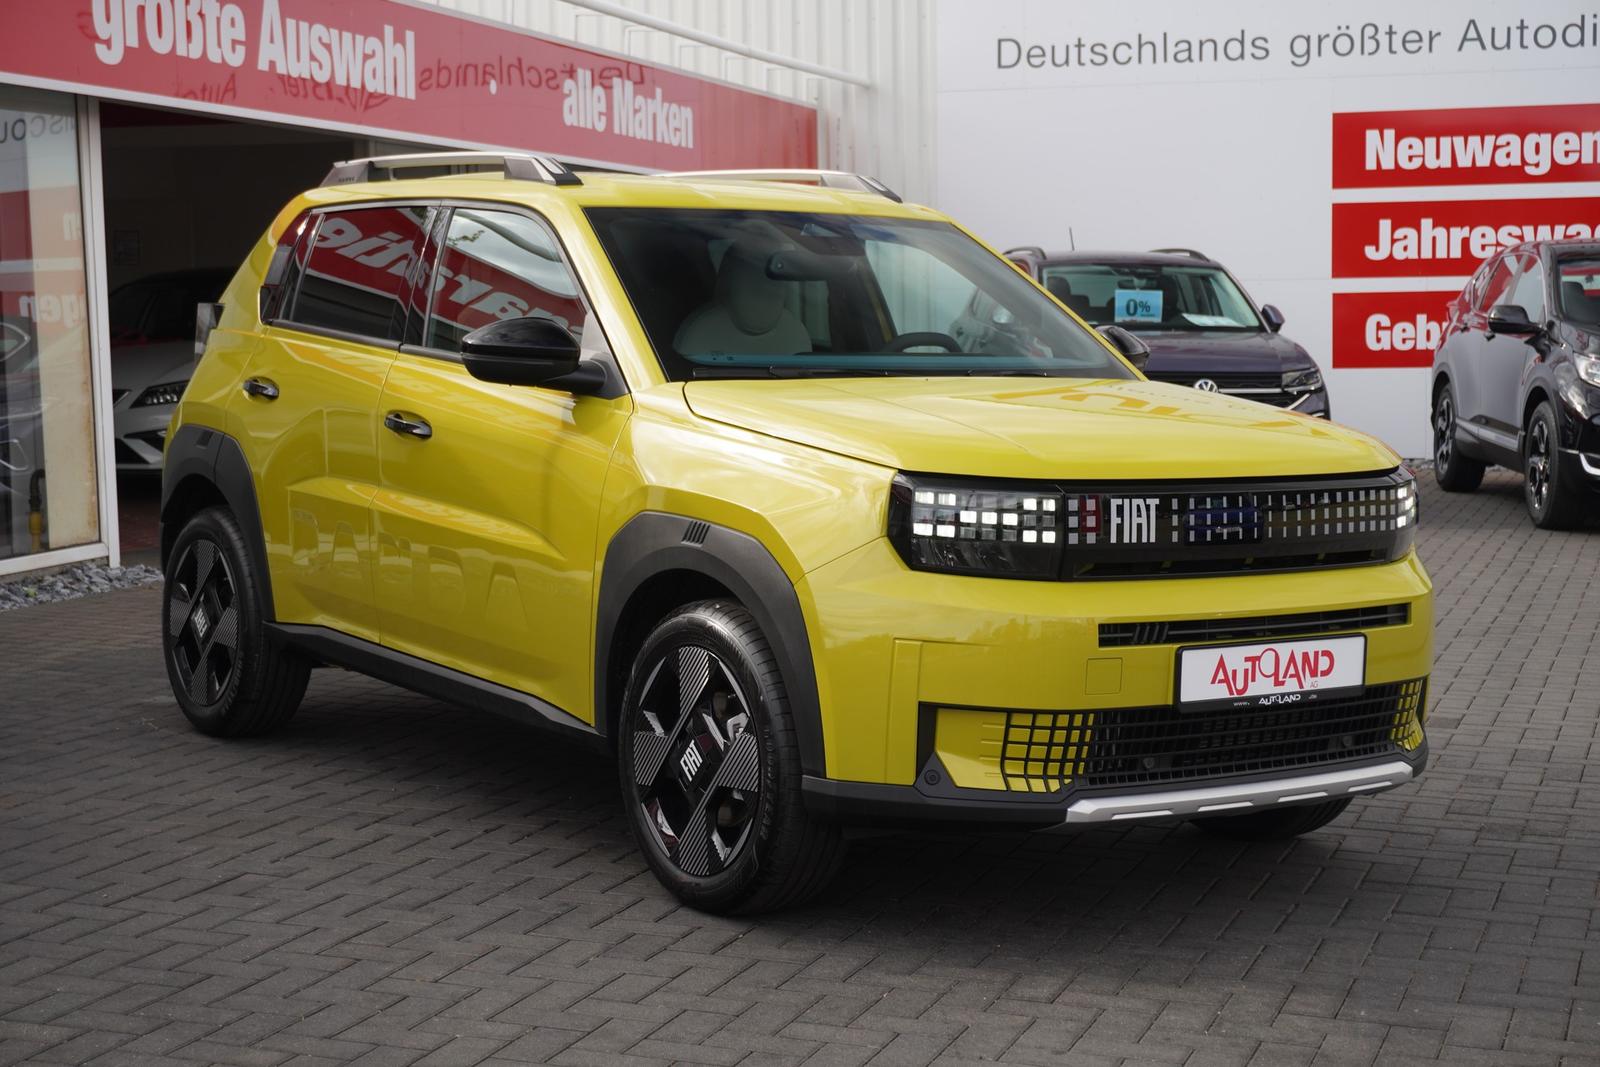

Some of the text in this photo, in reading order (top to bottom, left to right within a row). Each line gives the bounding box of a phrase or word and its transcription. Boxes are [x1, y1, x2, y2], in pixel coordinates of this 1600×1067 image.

[257, 0, 416, 101] Auswahl
[997, 29, 1270, 69] Deutschlands
[1290, 23, 1442, 67] größter
[563, 68, 694, 149] alle Marken
[1365, 129, 1600, 176] Neuwagen
[1125, 298, 1151, 317] 0%
[1365, 313, 1449, 352] Geb
[1110, 498, 1160, 543] FIAT
[680, 739, 703, 782] FIAT
